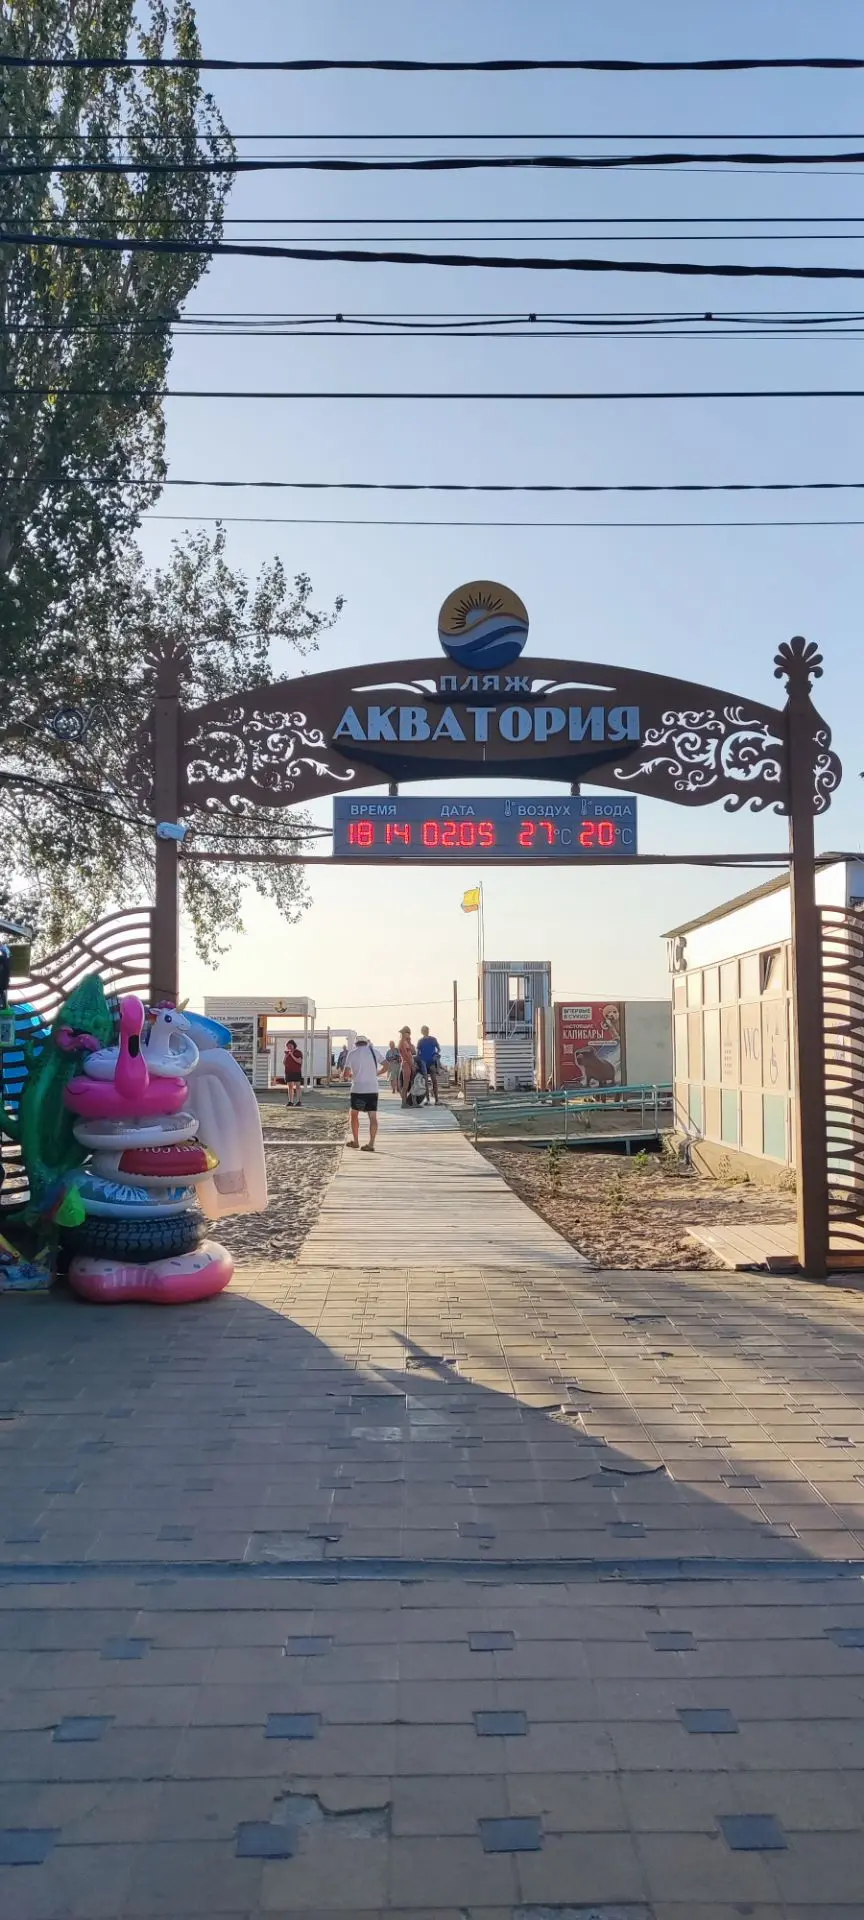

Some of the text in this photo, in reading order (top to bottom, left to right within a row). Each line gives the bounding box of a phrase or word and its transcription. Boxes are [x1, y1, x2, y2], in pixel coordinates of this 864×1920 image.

[439, 675, 531, 692] ПЛЯЖ
[332, 705, 640, 742] АКВАТОРИЯ
[350, 804, 632, 817] ВРЕМЯ ДАТА ВОЗДУХ ВОДА
[347, 821, 374, 847] 18
[384, 822, 410, 846] 14
[742, 1027, 760, 1061] WC
